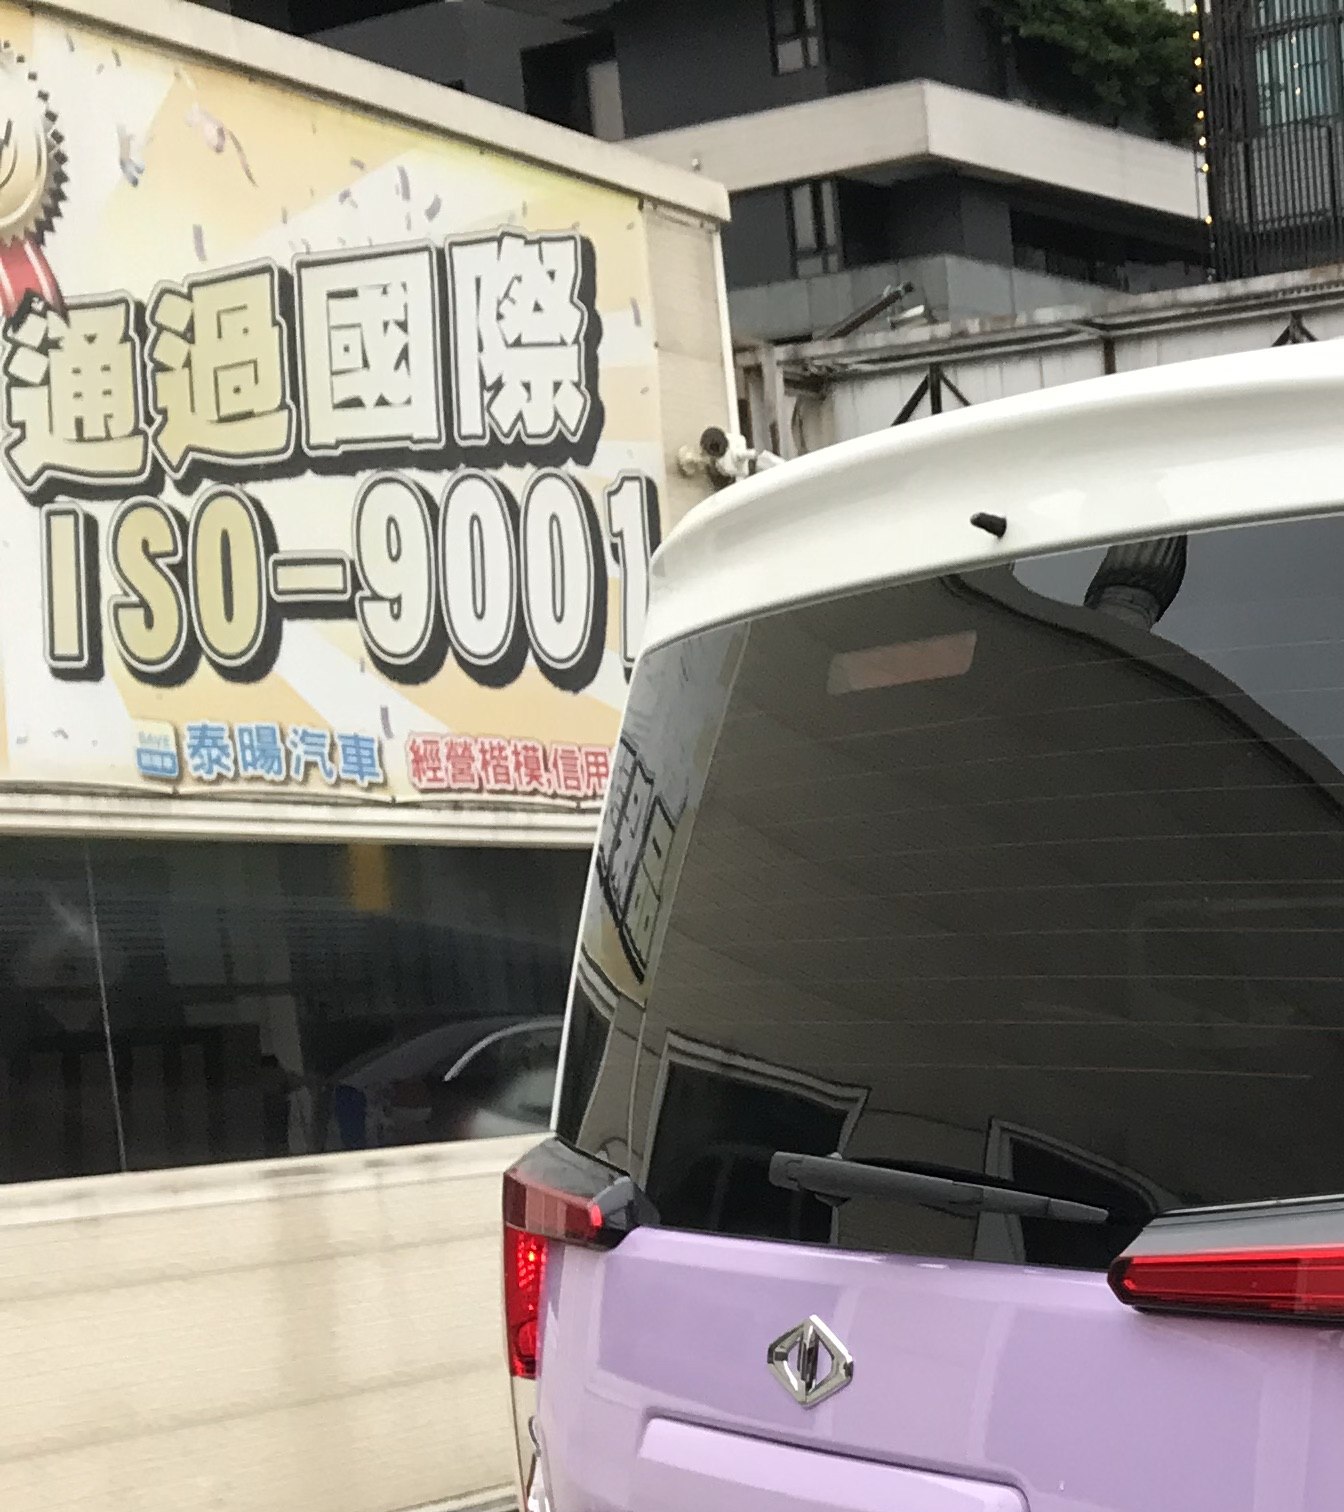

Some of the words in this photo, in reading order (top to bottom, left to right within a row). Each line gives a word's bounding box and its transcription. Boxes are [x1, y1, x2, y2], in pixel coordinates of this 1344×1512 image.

[3, 230, 598, 490] 通過國際
[41, 468, 662, 682] ISO-9001
[186, 724, 382, 784] 泰暘汽車
